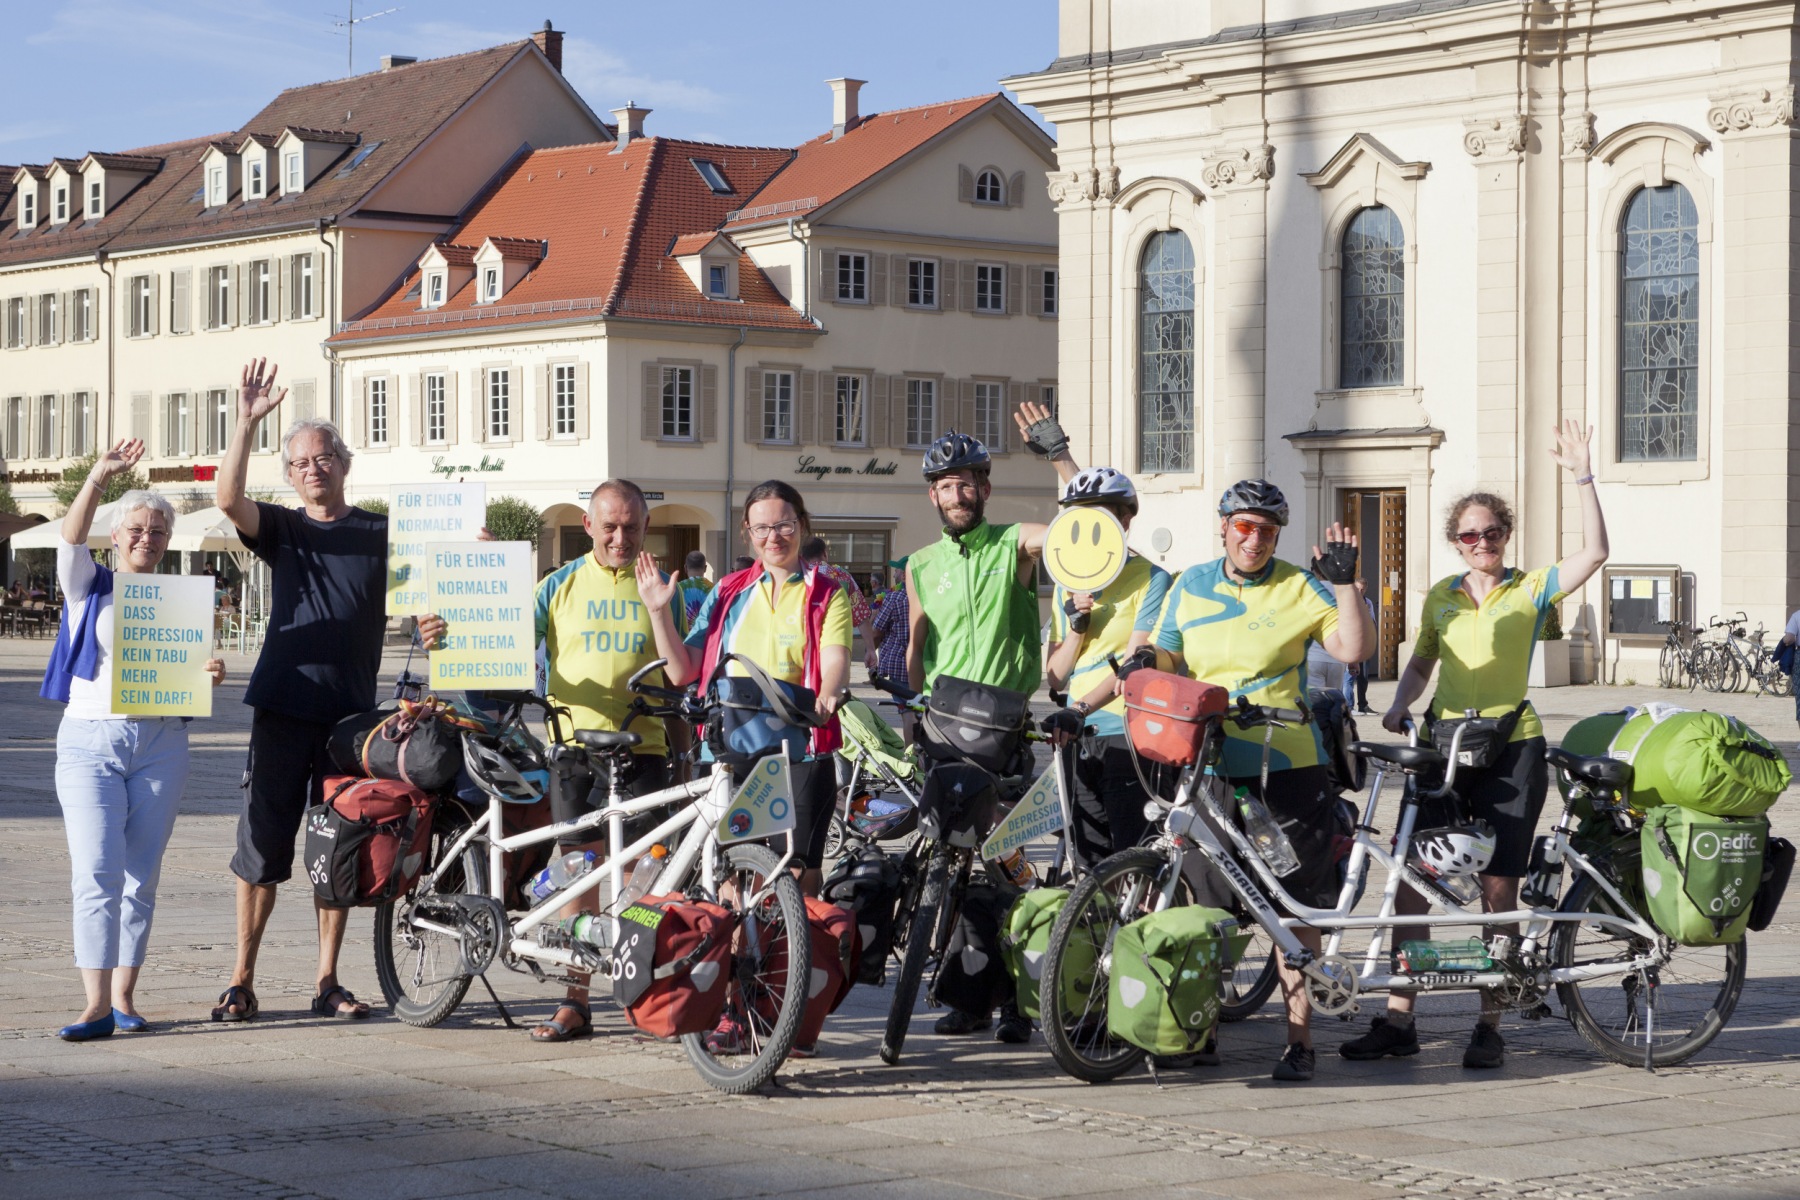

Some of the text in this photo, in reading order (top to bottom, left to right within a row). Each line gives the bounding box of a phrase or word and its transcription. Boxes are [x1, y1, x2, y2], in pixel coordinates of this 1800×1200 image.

[430, 454, 505, 480] Lange am Markt
[795, 455, 899, 481] Lange am Markt
[398, 492, 462, 507] FÜR EINEN
[397, 518, 462, 532] NORMALEN
[396, 543, 427, 557] UMG
[436, 551, 506, 568] FÜR EINEN
[395, 567, 422, 581] DEM
[124, 584, 163, 602] ZEIGT,
[437, 580, 508, 595] NORMALEN
[123, 605, 156, 621] DASS
[438, 607, 522, 622] UMGANG MIT
[587, 599, 642, 621] MUT
[122, 626, 204, 643] DEPRESSION
[439, 634, 516, 650] DEM THEMA
[580, 630, 647, 655] TOUR
[122, 647, 188, 664] KEIN TABU
[121, 668, 158, 683] MEHR
[439, 662, 528, 678] DEPRESSION!
[120, 690, 193, 705] SEIN DARF!
[744, 775, 763, 799] MUT
[752, 782, 775, 809] TOUR
[1008, 800, 1060, 832] DEPRESSIO
[986, 815, 1063, 857] IST BEHANDELBA
[1721, 833, 1757, 850] adfc
[1216, 851, 1270, 913] SCHAUFF
[1406, 869, 1450, 906] mut-tour.de
[1408, 974, 1478, 985] SCHAUFF
